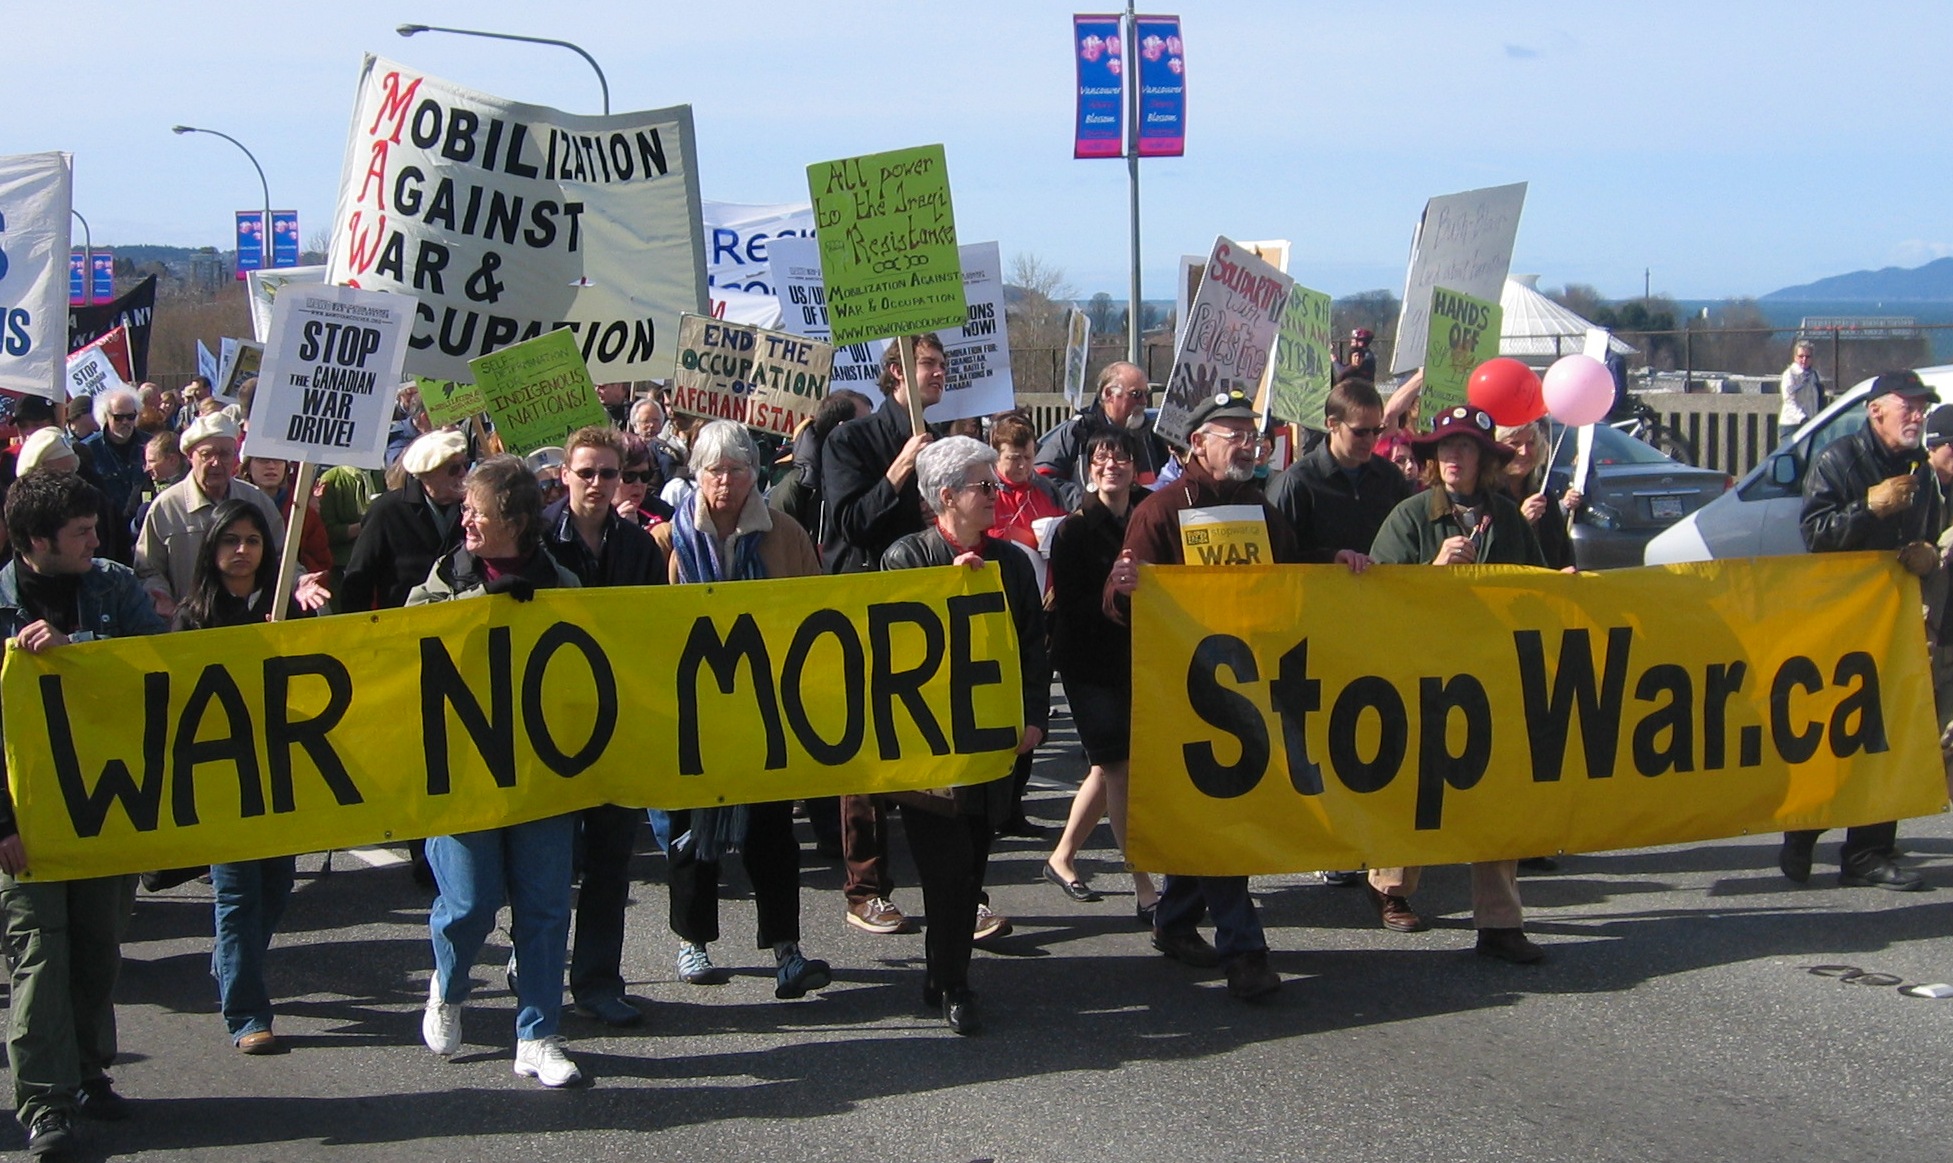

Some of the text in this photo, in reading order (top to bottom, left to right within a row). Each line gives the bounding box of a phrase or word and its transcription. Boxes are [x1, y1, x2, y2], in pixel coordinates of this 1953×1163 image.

[370, 71, 668, 183] MOBILIZATION
[357, 140, 585, 253] AGAINST
[826, 157, 934, 200] All power
[815, 196, 841, 230] to
[853, 189, 886, 221] the
[349, 211, 505, 304] WAR &
[846, 214, 955, 266] Resistance
[829, 278, 907, 302] MOBILIZATION
[910, 271, 961, 288] AGAINST
[835, 303, 865, 319] WAR
[881, 293, 956, 310] OCCUPATION
[1210, 244, 1289, 324] SOLIDARITY
[802, 306, 818, 326] OF
[1433, 291, 1490, 331] HANDS
[299, 320, 381, 367] STOP
[704, 324, 813, 365] END THE
[72, 360, 98, 386] STOP
[289, 366, 377, 395] THE CANADIAN
[491, 366, 584, 413] INDIGENOUS
[682, 348, 826, 401] OCCUPATION
[303, 388, 353, 420] WAR
[506, 385, 588, 430] NATIONS!
[674, 385, 815, 434] AFGHANISTA
[286, 414, 356, 447] DRIVE!
[1197, 542, 1262, 566] WAR
[39, 591, 1018, 839] WAR NO MORE
[1182, 625, 1889, 831] Stop War.ca
